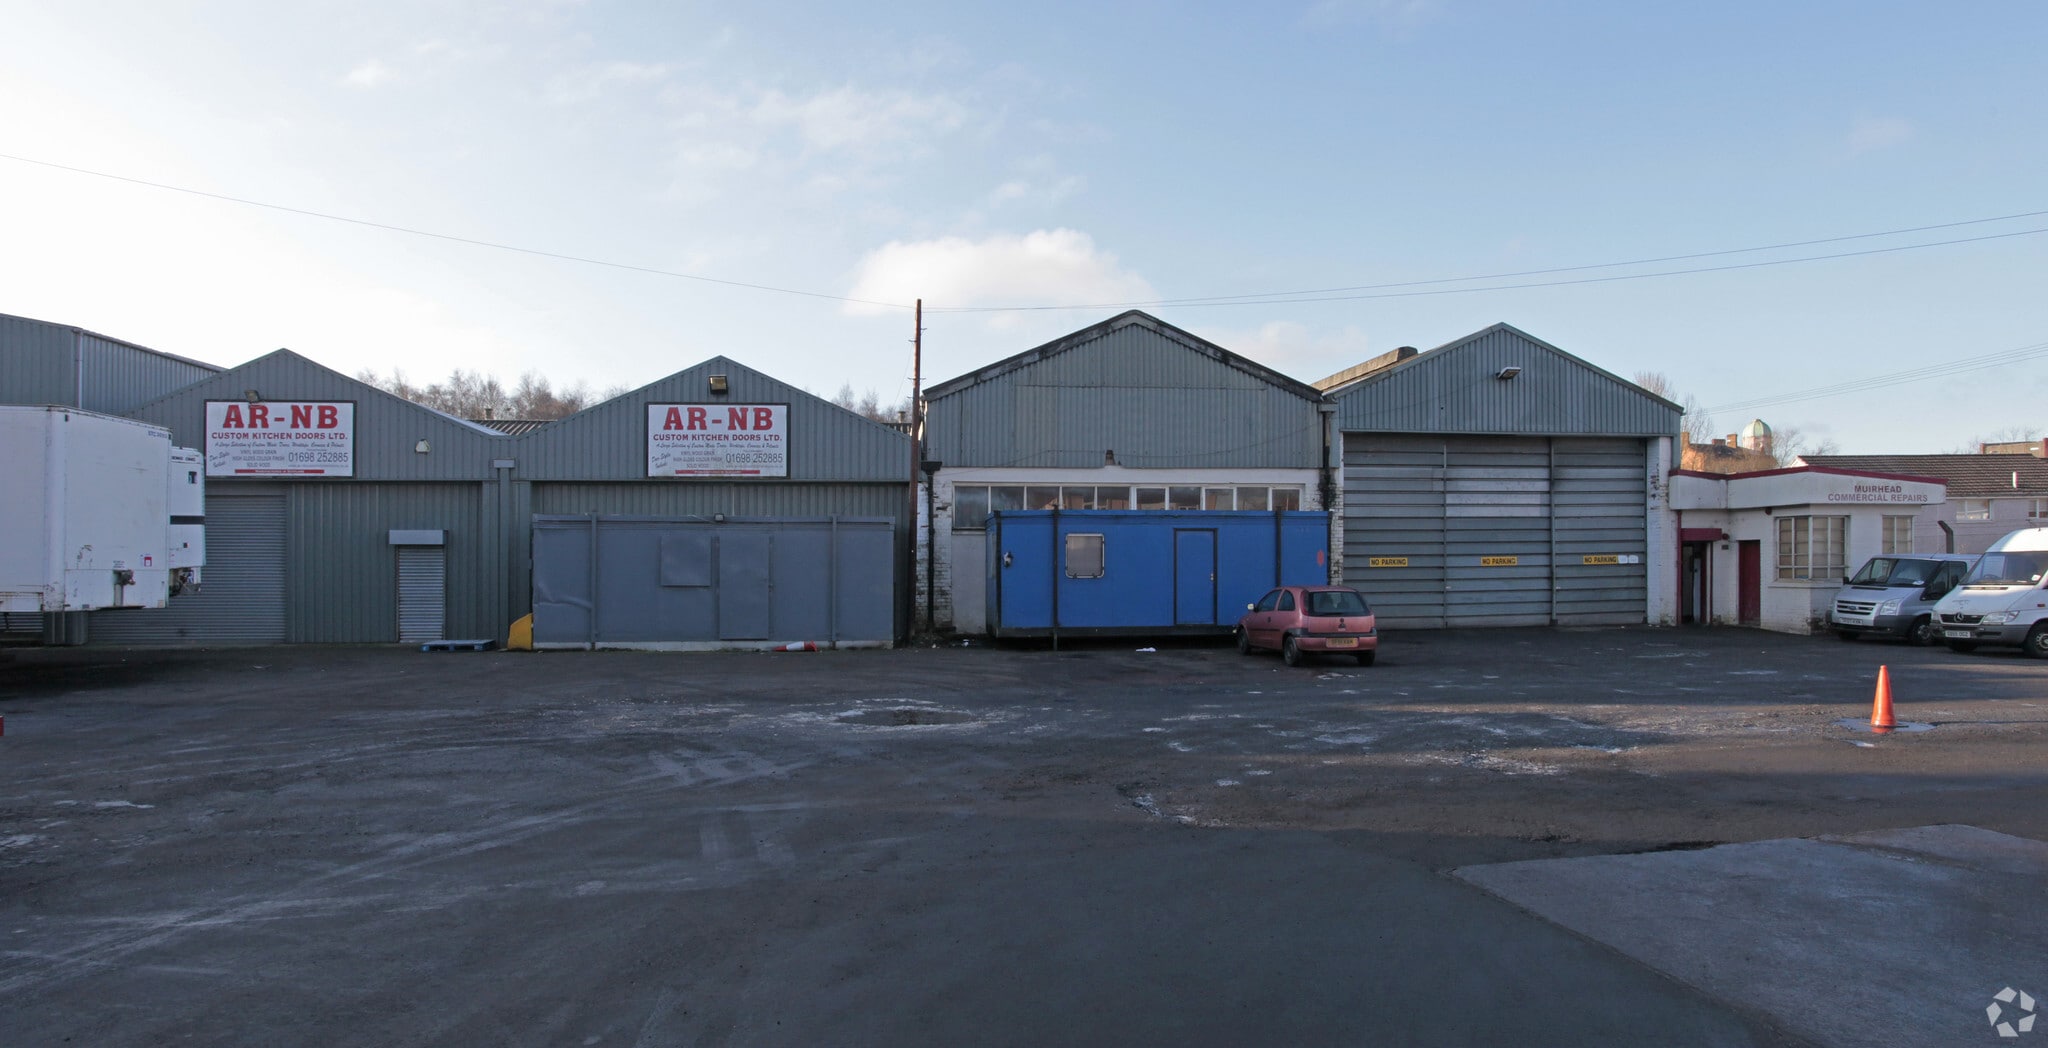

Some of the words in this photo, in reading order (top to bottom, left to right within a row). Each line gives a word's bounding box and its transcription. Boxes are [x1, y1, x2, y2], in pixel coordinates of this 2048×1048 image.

[222, 404, 338, 429] AR-NB
[663, 407, 773, 430] AR-NB
[288, 452, 315, 462] 01698
[317, 452, 349, 462] 252885
[726, 453, 750, 463] 01698
[753, 453, 783, 463] 252885
[1828, 494, 1888, 502] COMMERCIAL
